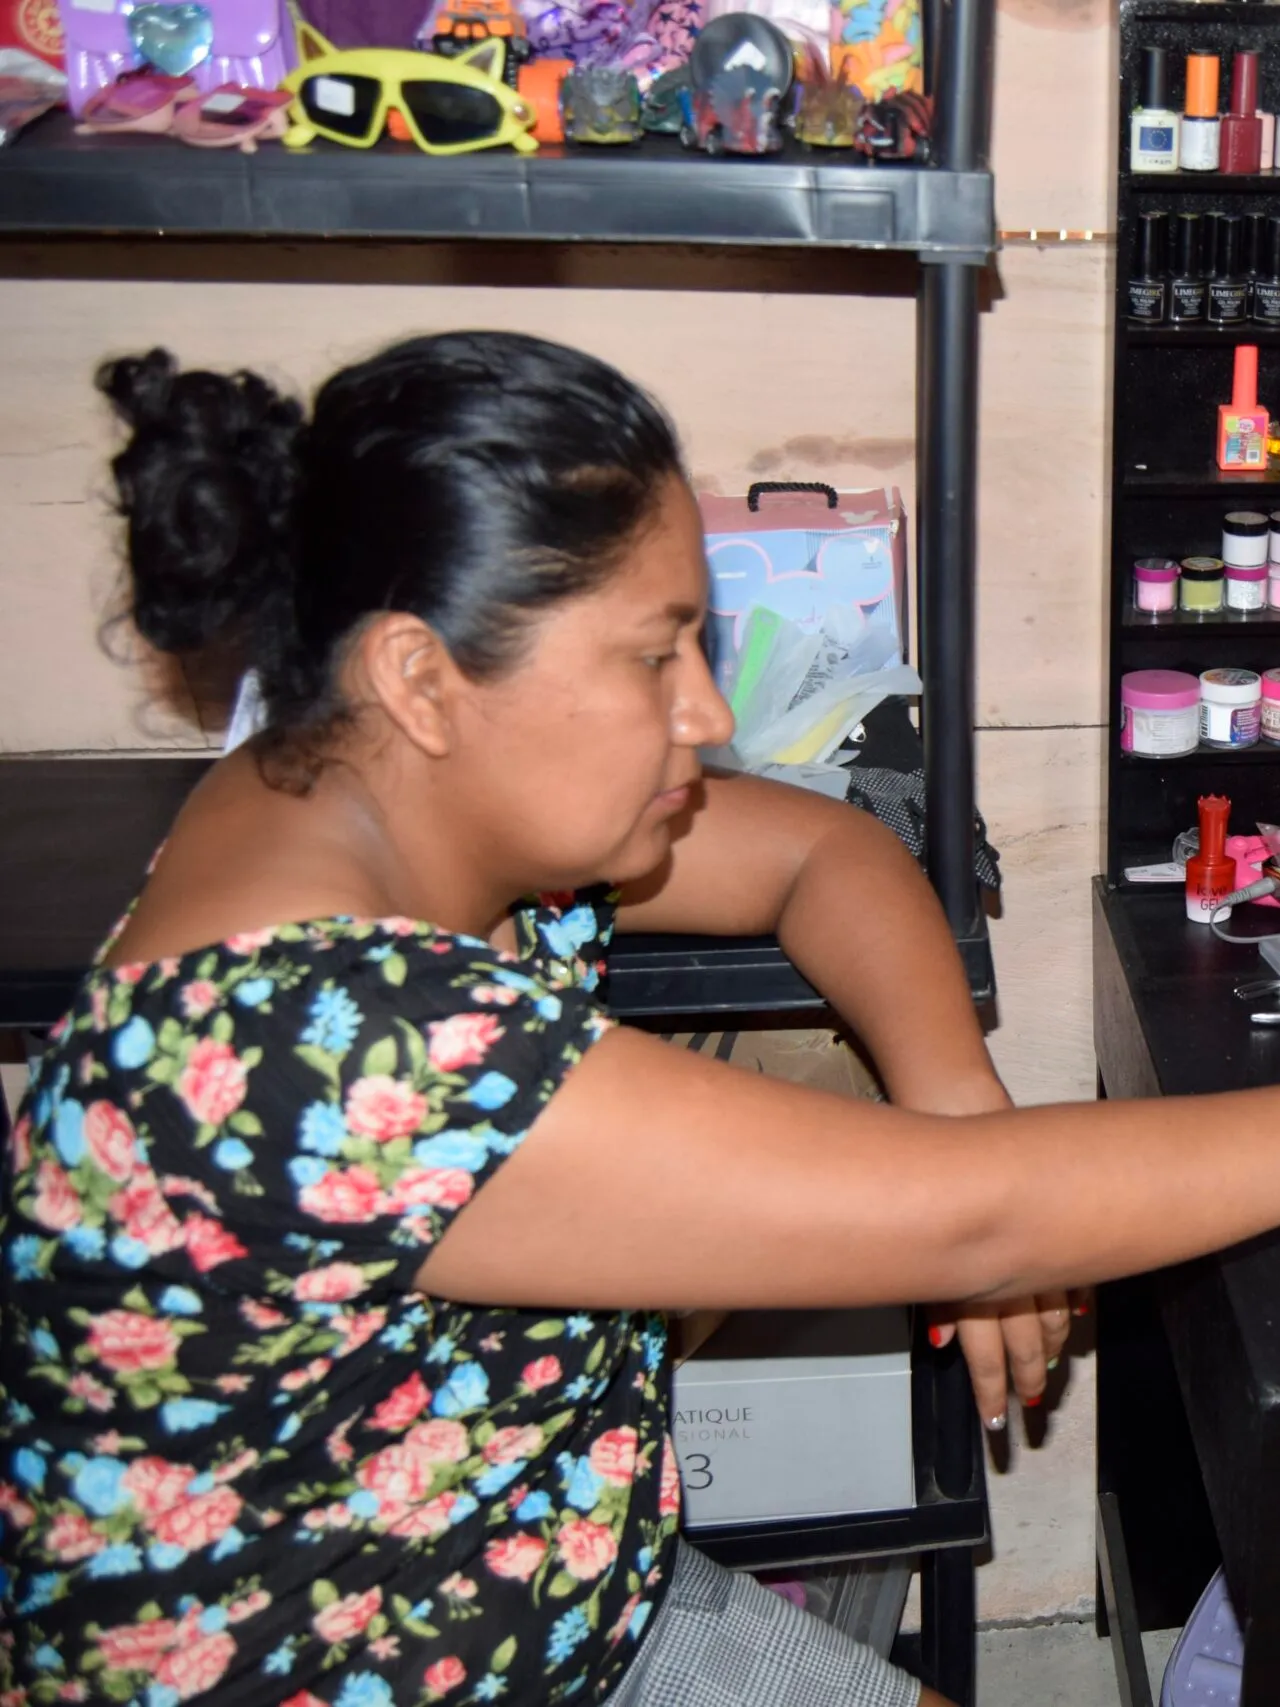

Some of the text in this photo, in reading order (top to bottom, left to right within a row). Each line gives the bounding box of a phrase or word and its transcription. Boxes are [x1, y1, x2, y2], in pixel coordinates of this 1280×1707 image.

[673, 1407, 755, 1425] ATIQUE
[678, 1427, 751, 1442] SIONAL
[684, 1453, 713, 1490] 3
